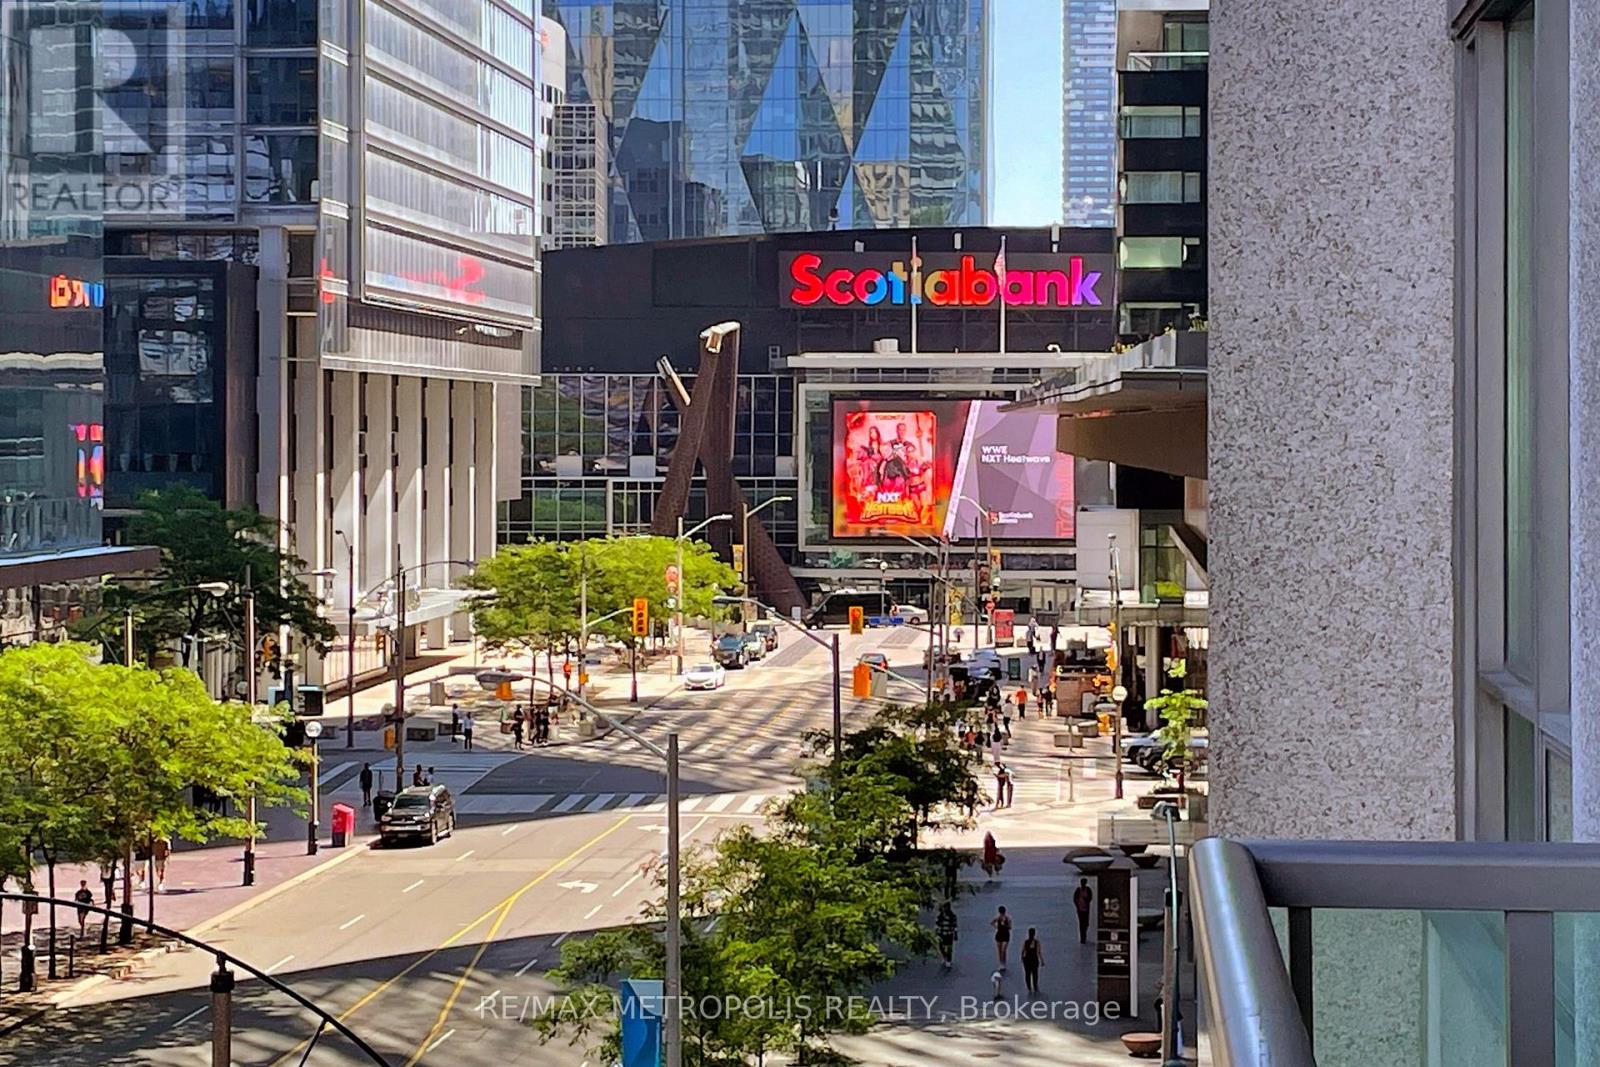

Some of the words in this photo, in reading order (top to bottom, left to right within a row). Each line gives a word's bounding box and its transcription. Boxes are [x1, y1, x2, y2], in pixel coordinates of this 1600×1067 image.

[791, 253, 1103, 306] Scotiabank
[981, 445, 1008, 454] WWE
[981, 454, 1002, 463] NXT
